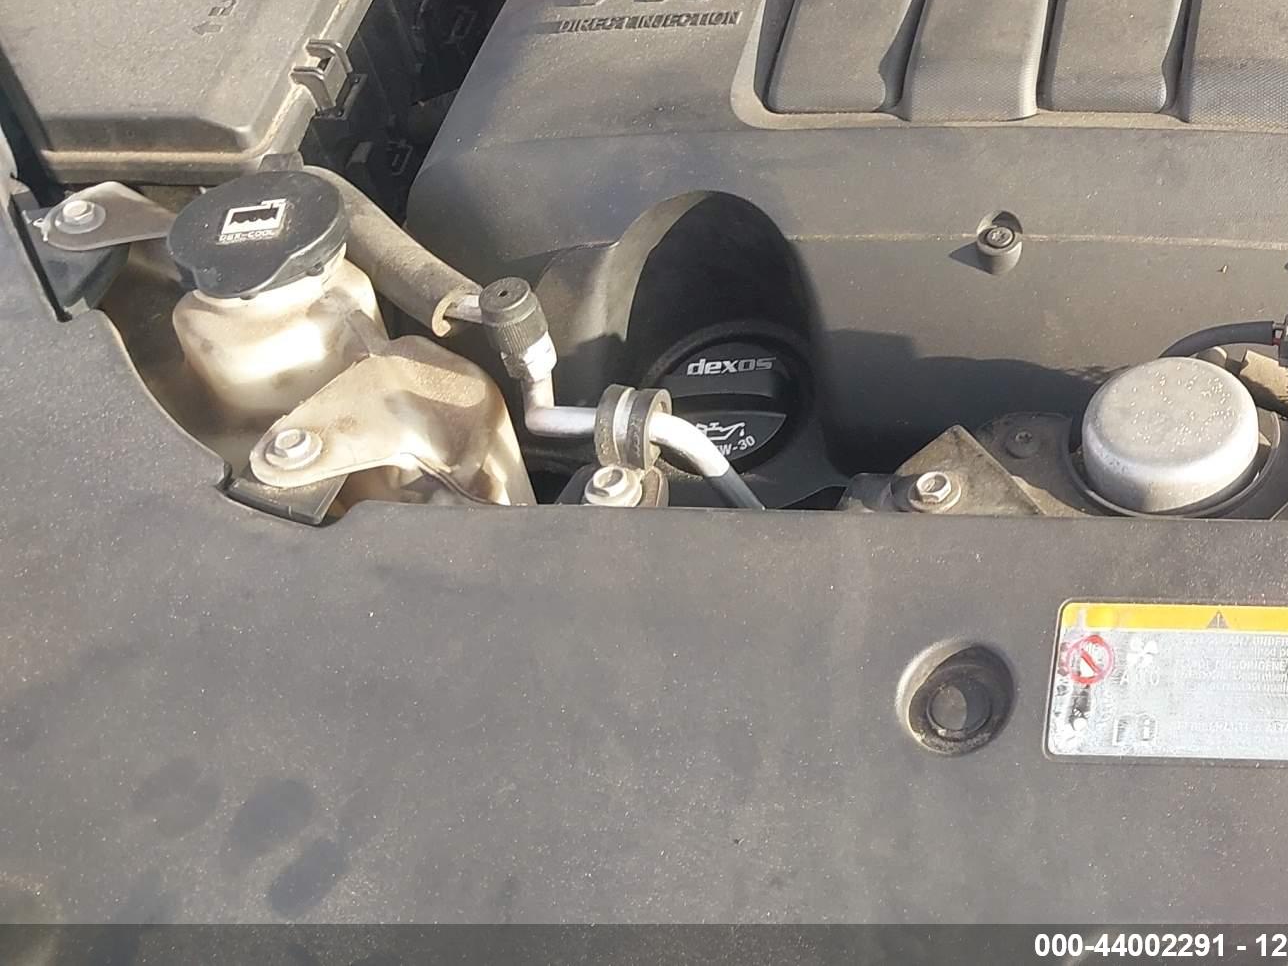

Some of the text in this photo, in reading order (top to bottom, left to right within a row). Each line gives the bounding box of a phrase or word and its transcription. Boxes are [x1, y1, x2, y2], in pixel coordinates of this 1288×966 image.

[558, 15, 625, 33] DIRECT
[686, 356, 776, 376] dexos
[716, 435, 756, 456] W-30
